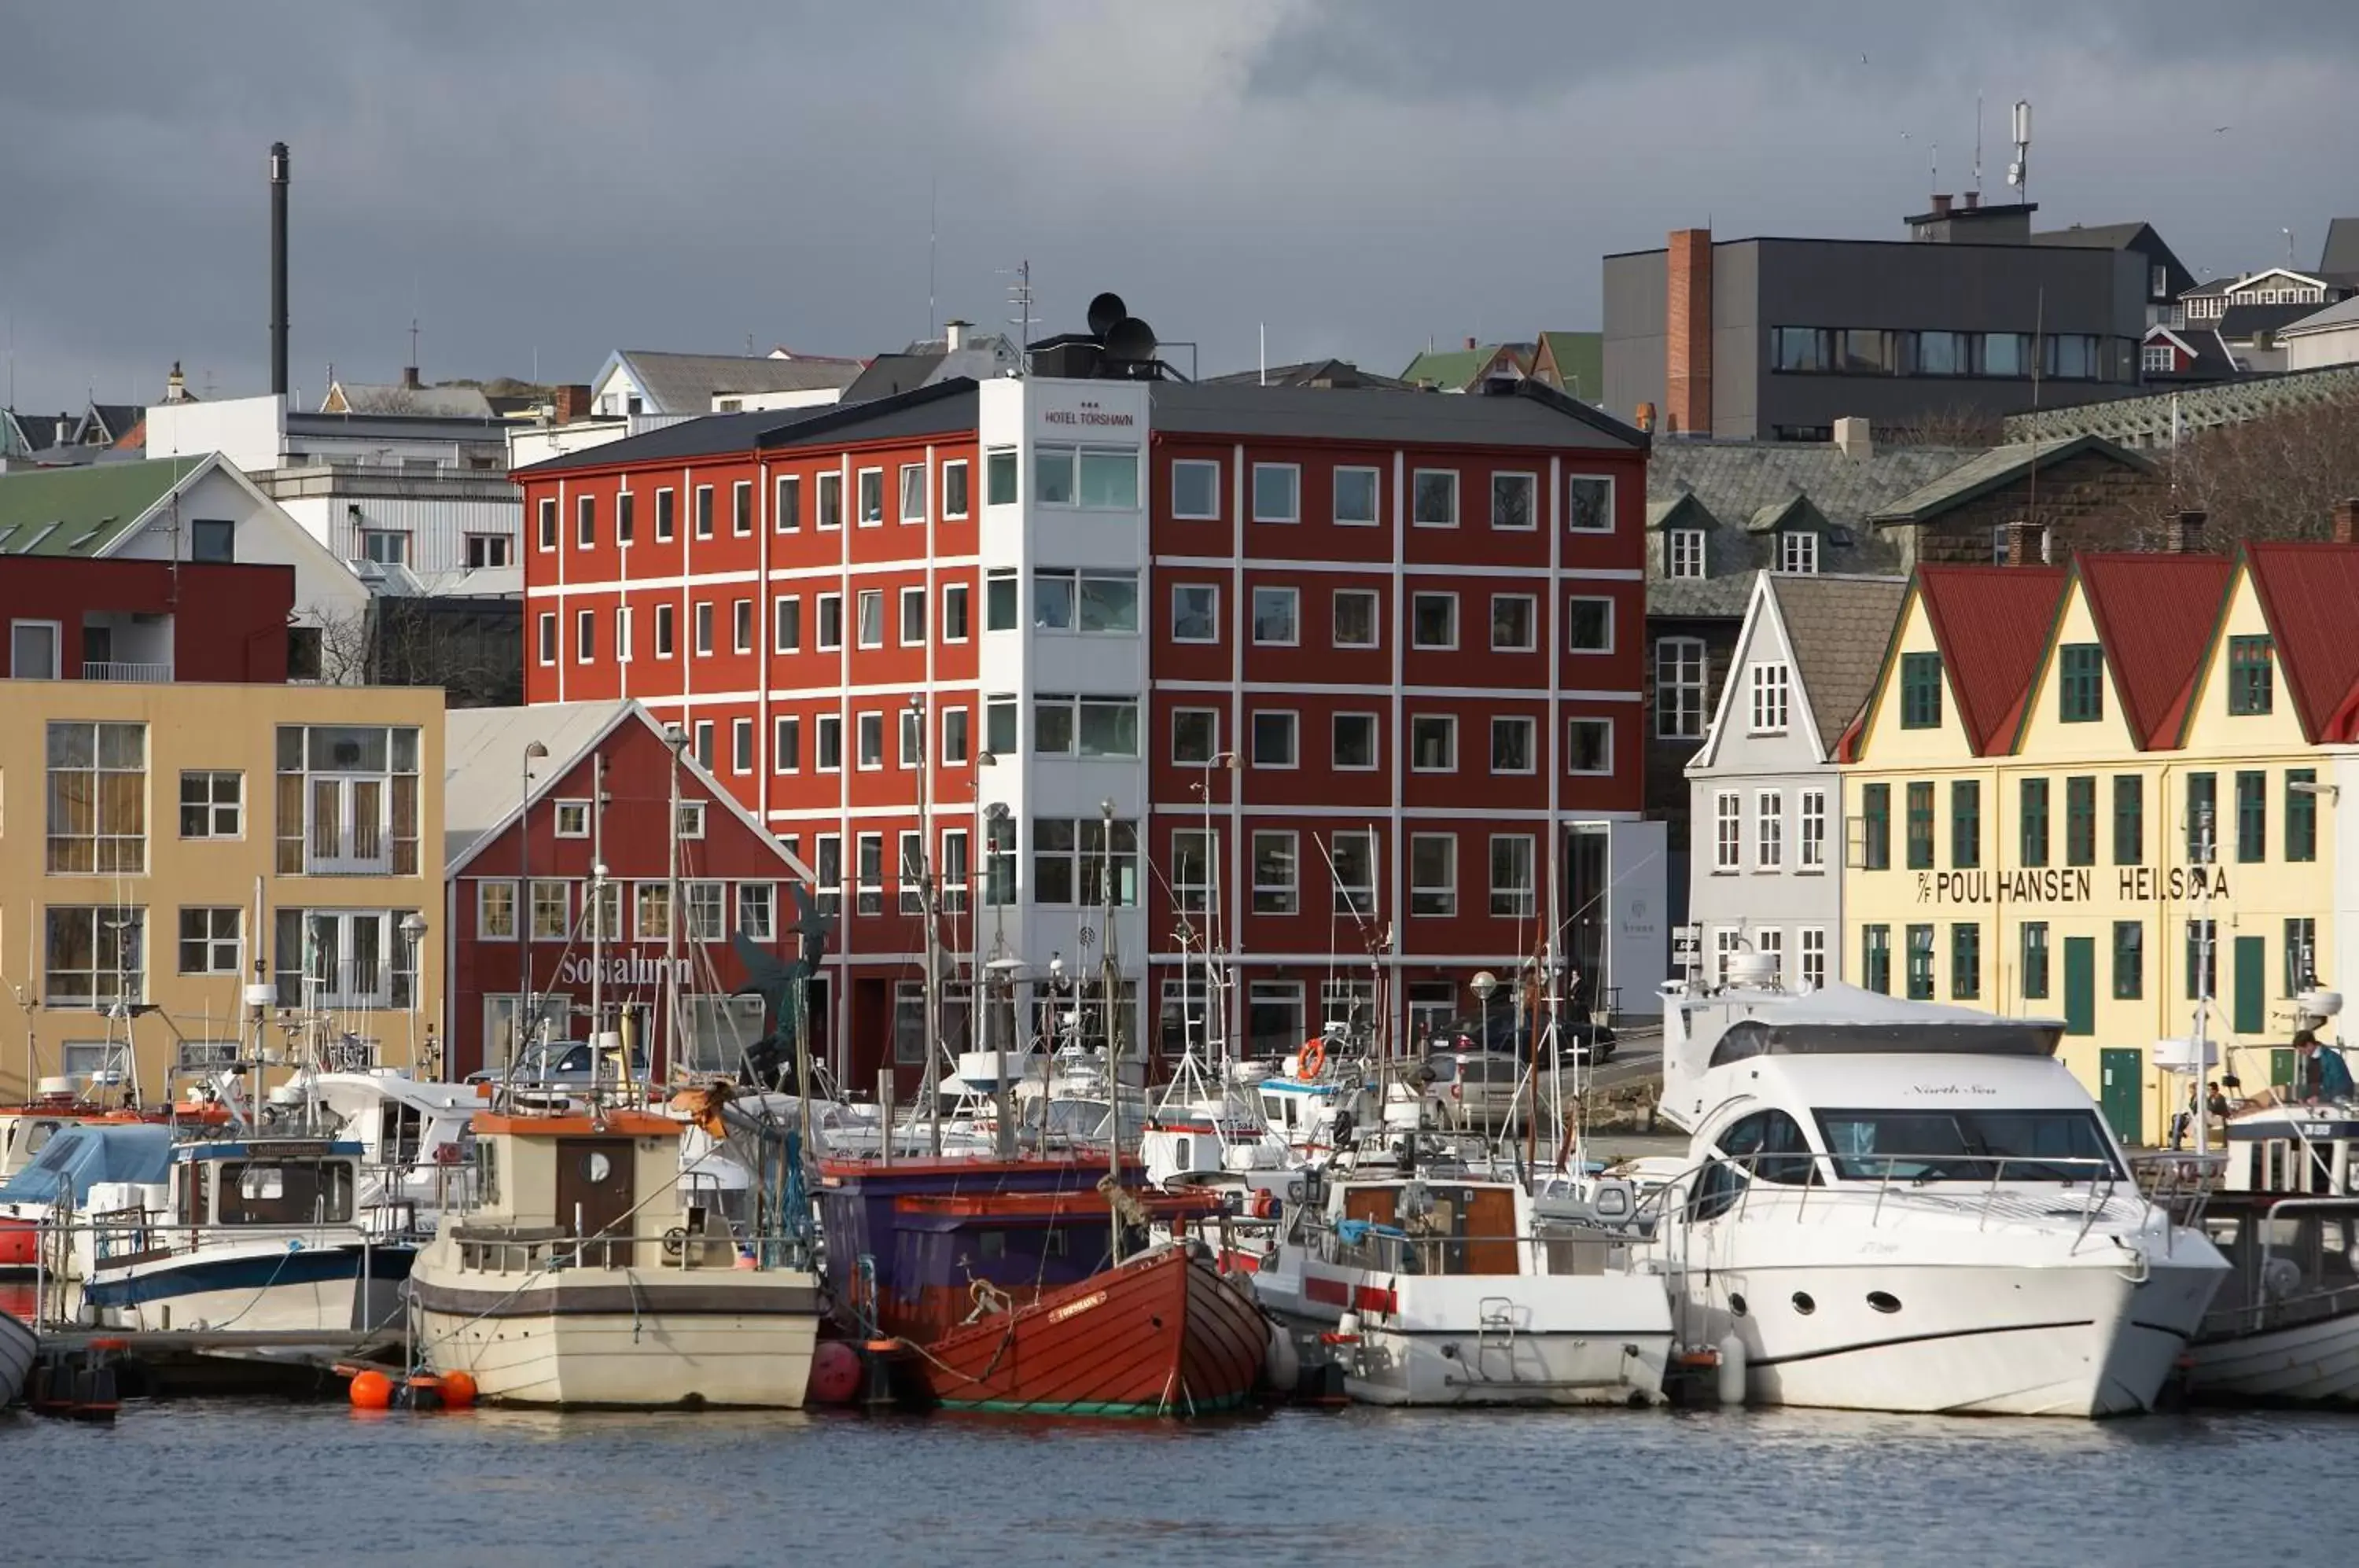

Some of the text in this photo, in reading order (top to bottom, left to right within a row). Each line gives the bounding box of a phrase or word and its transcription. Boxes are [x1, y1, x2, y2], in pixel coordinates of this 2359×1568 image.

[1045, 411, 1077, 425] HOTEL
[1937, 871, 1992, 904] POUL
[1997, 868, 2091, 903] HANSEN
[2119, 866, 2229, 900] HEILSØA
[562, 947, 692, 984] Sosialurn
[1902, 1084, 1997, 1096] North Sea
